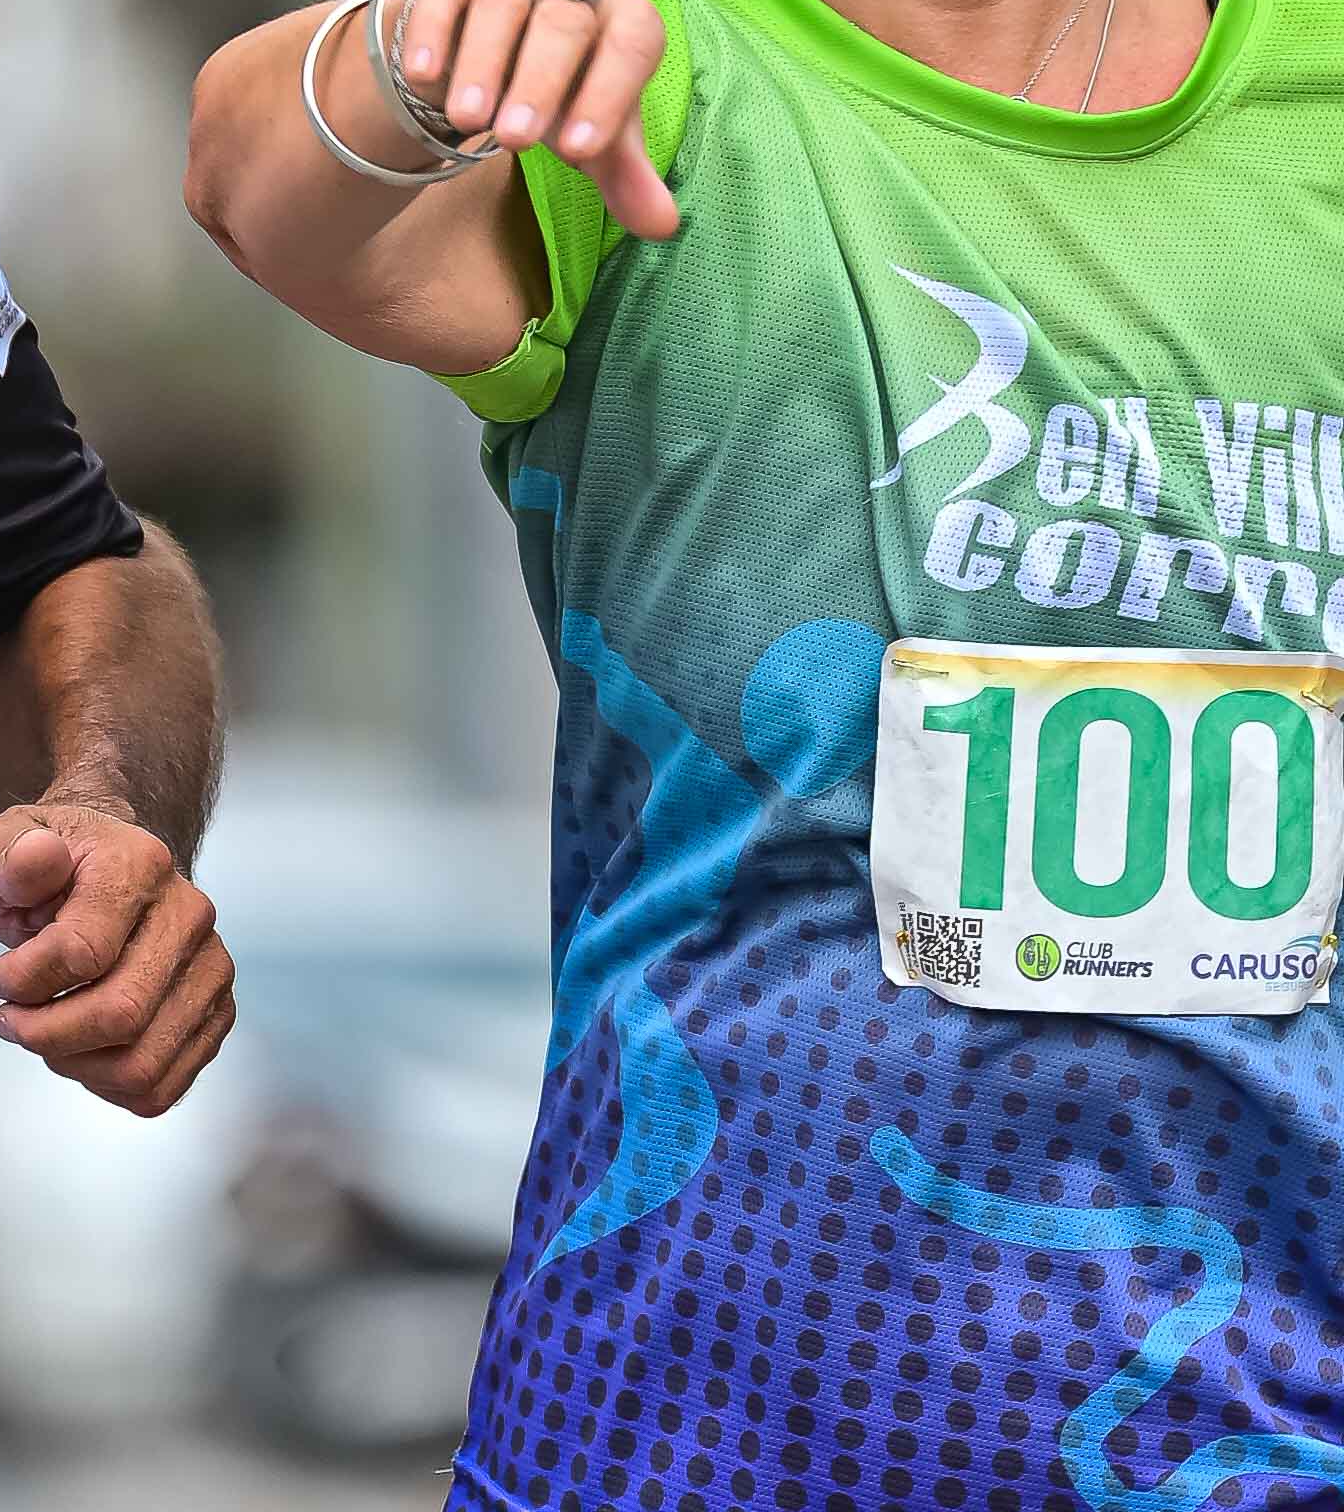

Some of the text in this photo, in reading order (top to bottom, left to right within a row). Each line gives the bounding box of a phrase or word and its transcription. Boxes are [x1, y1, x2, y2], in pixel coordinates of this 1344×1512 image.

[923, 686, 1316, 921] 100
[1066, 941, 1113, 959] CLUB
[1062, 959, 1154, 978] RUNNER'S
[1190, 953, 1318, 980] CARUSO
